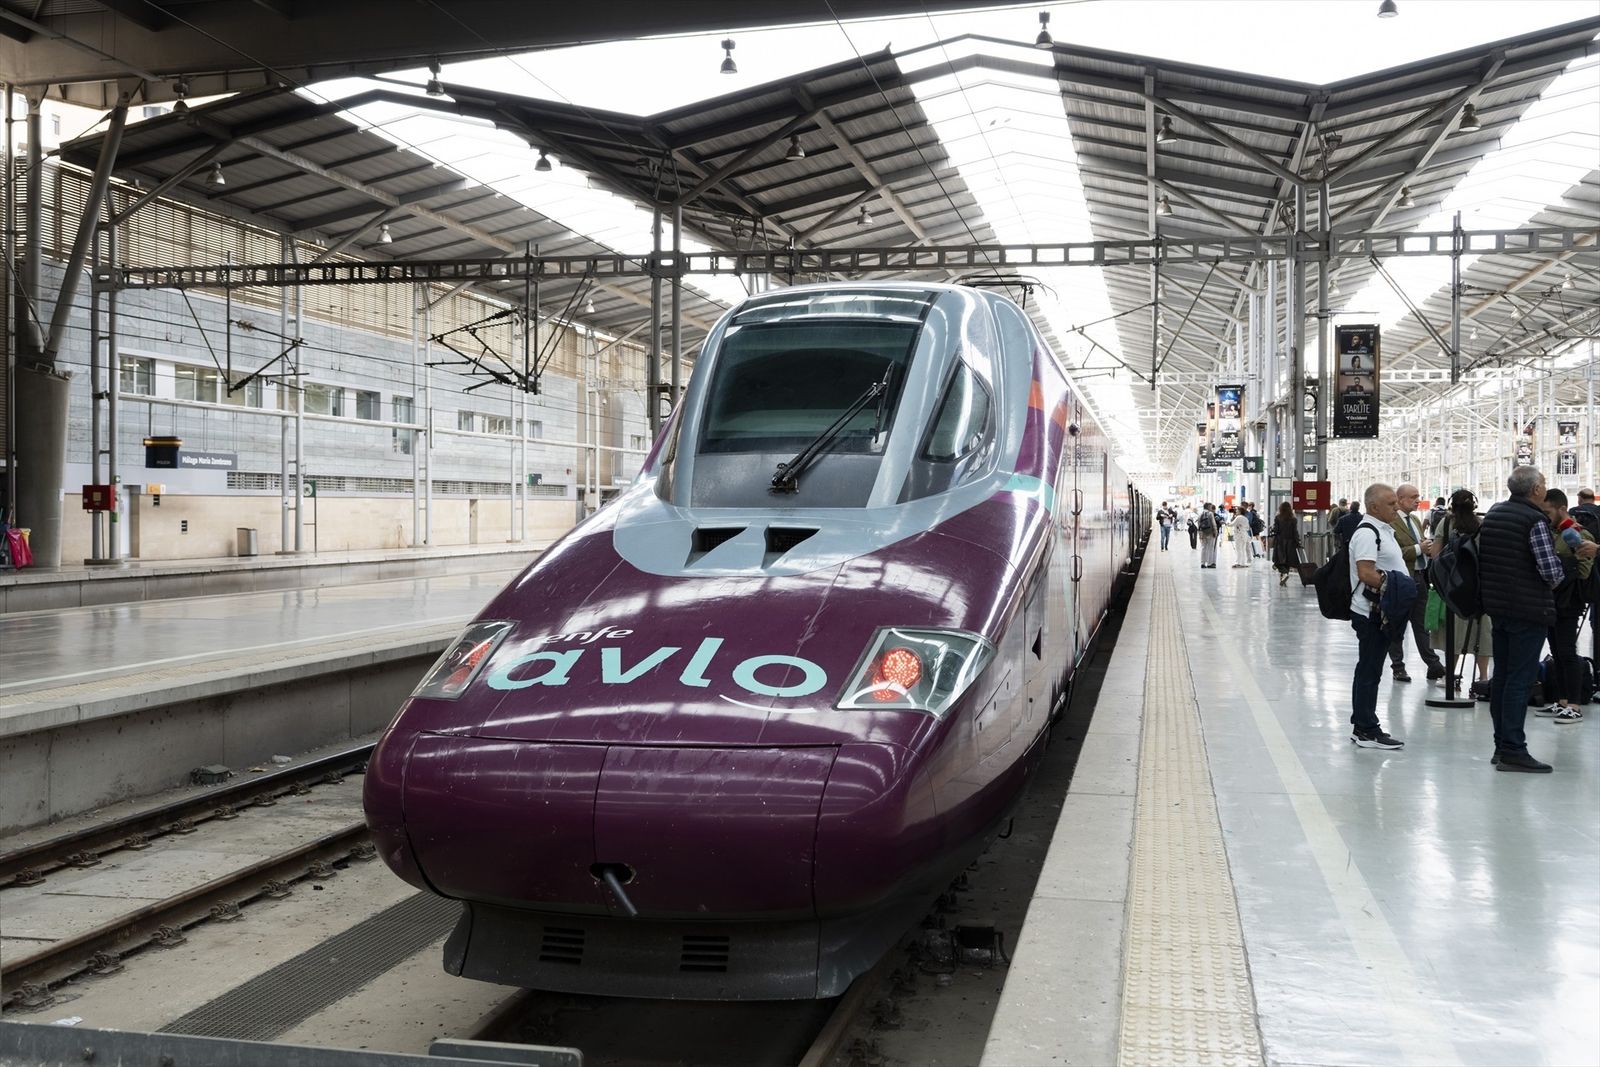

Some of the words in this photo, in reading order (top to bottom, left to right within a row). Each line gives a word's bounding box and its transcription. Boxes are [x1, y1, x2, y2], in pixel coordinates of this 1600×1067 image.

[1343, 403, 1370, 414] STARLITE
[538, 625, 634, 645] enfe
[487, 637, 828, 697] avlo
